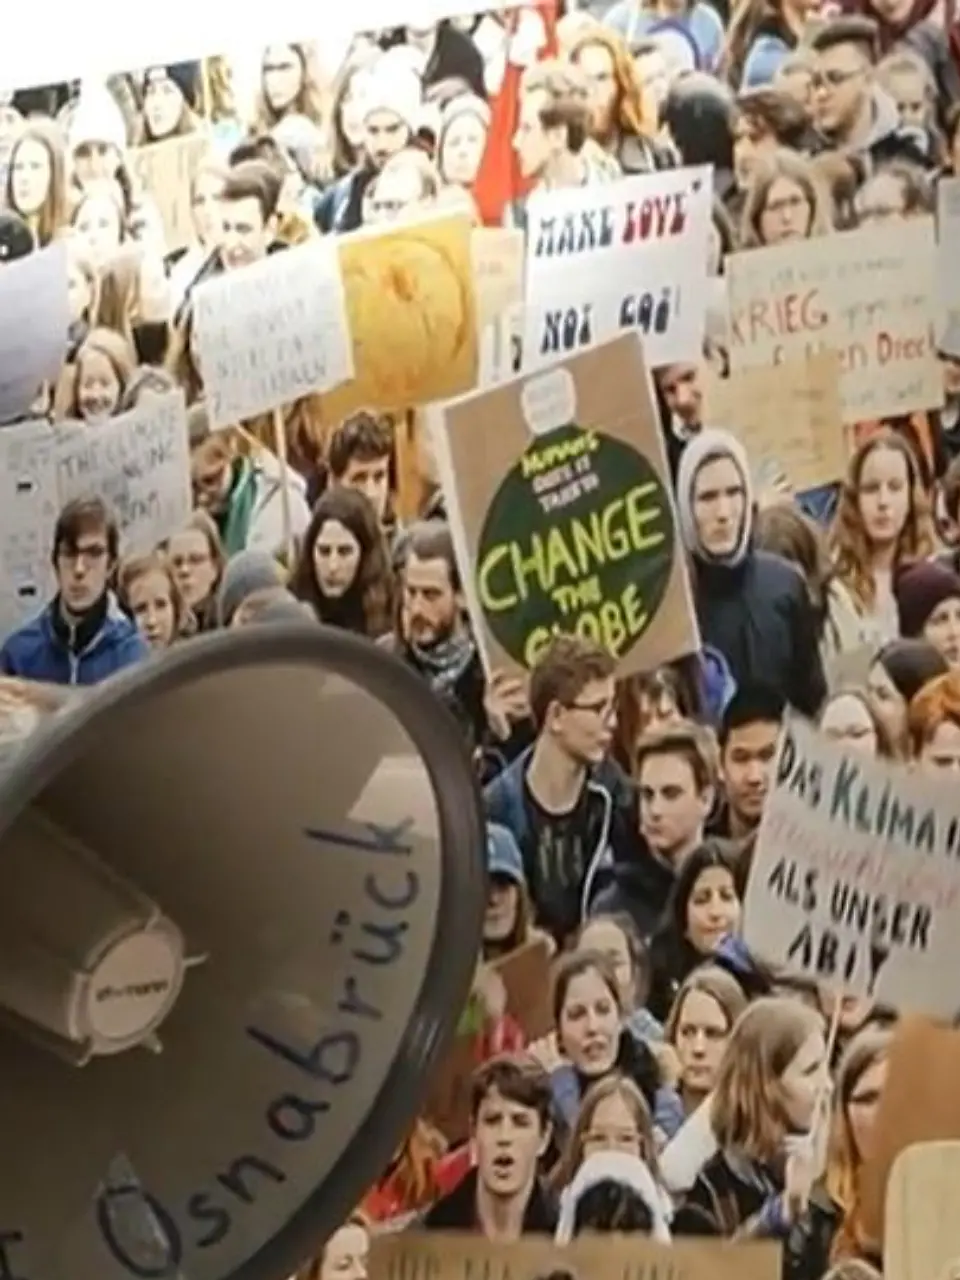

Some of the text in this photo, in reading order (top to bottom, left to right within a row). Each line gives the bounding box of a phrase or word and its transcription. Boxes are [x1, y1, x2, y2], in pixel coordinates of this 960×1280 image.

[478, 481, 666, 612] CHANGE
[829, 756, 938, 855] KLIMA
[767, 857, 819, 912] ALS
[830, 879, 933, 950] UNSER
[96, 813, 420, 1279] Osnabrück
